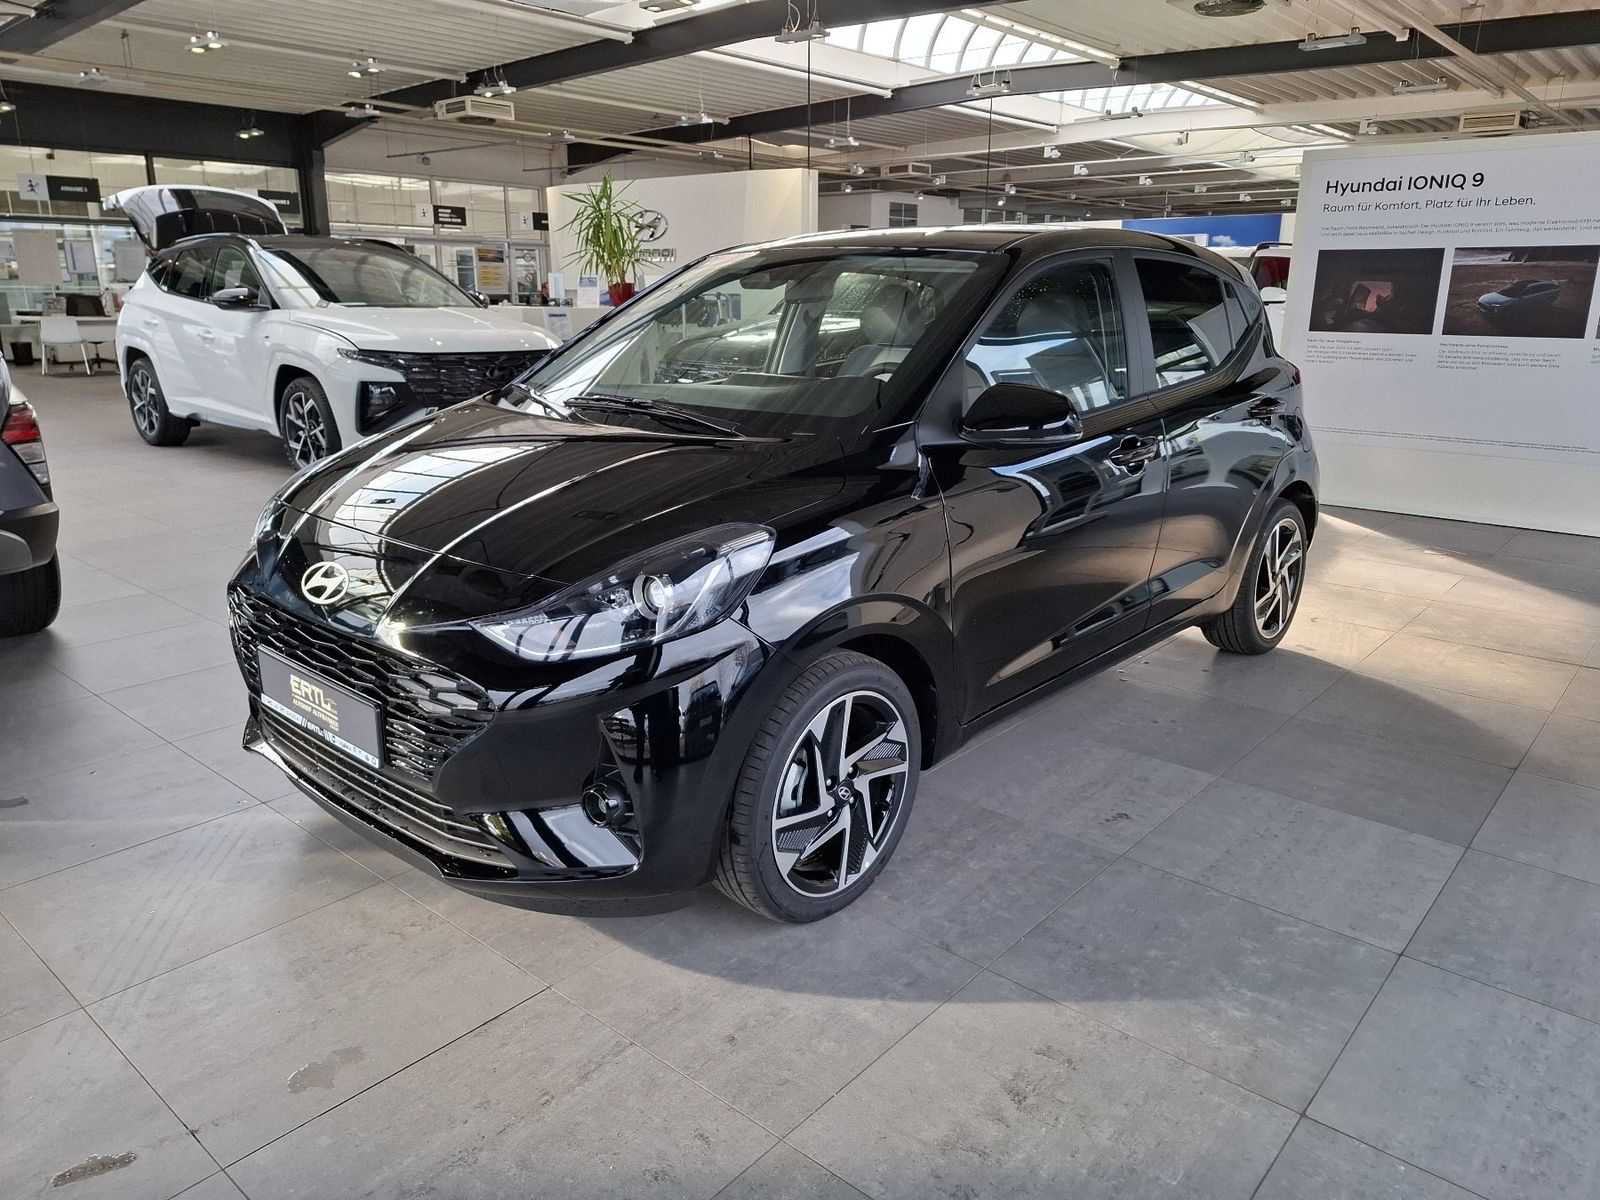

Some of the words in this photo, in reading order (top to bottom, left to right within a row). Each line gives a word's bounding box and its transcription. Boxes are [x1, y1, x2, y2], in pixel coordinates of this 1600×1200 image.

[1325, 176, 1403, 196] Hyundai
[1407, 173, 1467, 190] IONIQ
[1471, 172, 1485, 187] 9
[1323, 203, 1355, 213] Raum
[1357, 201, 1373, 212] für
[1375, 200, 1422, 211] Komfort.
[1425, 199, 1453, 209] Platz
[1457, 197, 1473, 208] für
[1475, 197, 1492, 207] Ihr
[1494, 195, 1536, 206] Leben.
[290, 674, 333, 711] ERTL
